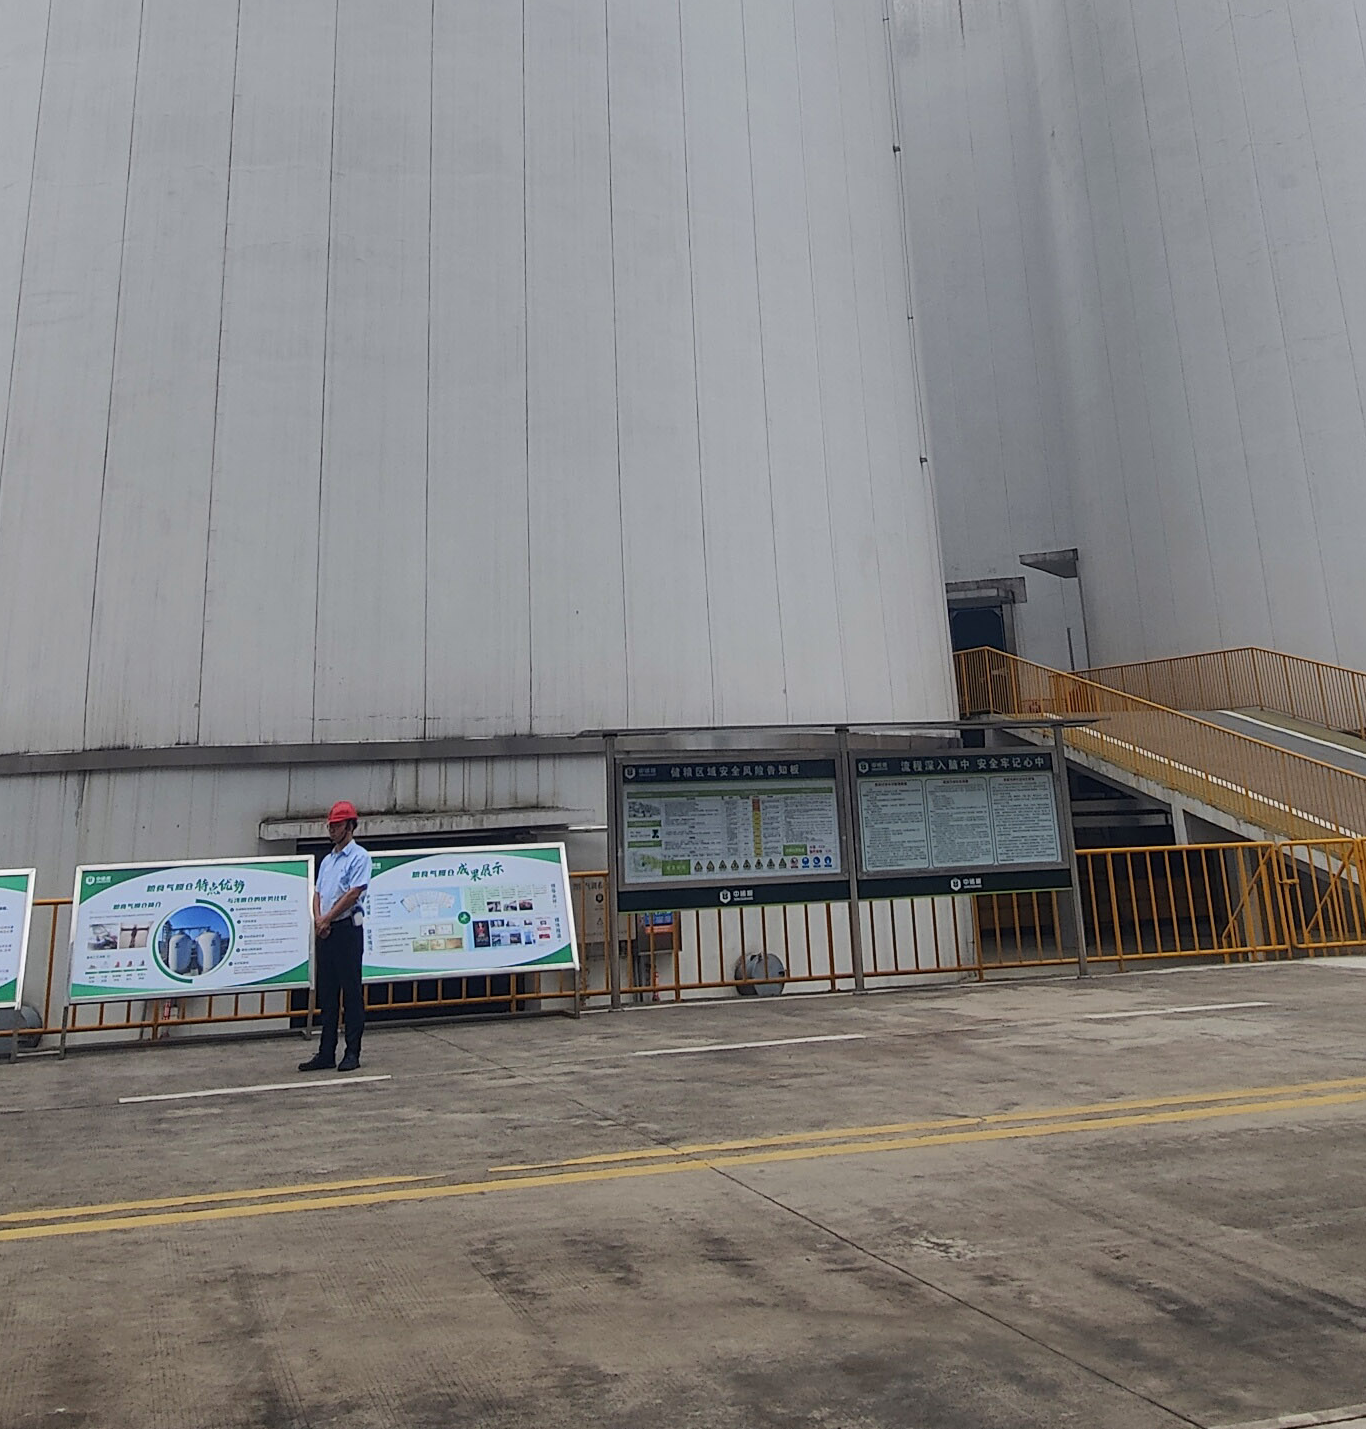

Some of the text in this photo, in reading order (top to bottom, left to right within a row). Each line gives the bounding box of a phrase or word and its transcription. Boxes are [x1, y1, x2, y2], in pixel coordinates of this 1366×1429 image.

[976, 756, 1045, 770] 安全牢记心中
